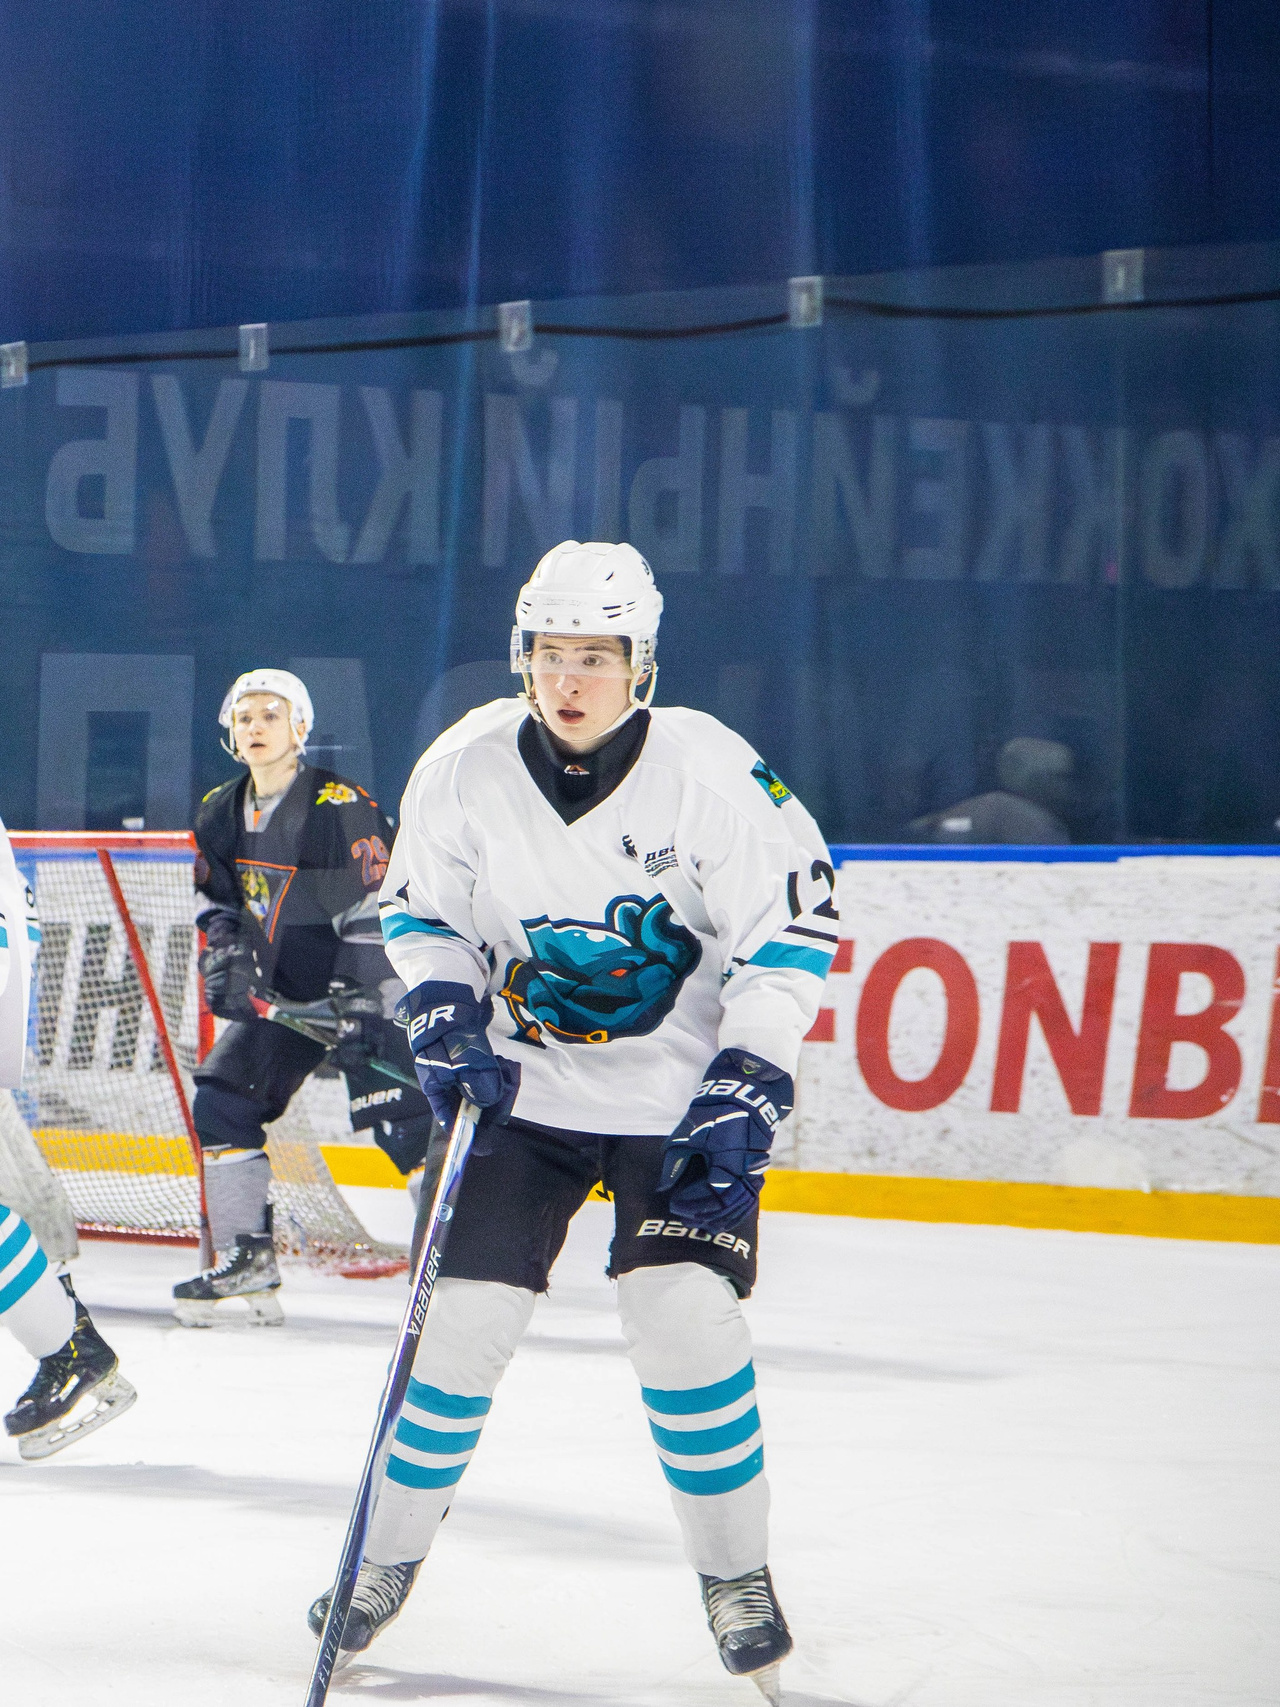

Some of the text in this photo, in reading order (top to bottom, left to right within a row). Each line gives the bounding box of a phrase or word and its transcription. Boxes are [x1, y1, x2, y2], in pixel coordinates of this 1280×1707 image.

[786, 859, 840, 920] 12
[636, 1219, 751, 1260] BAUER
[413, 1245, 442, 1327] BAUER
